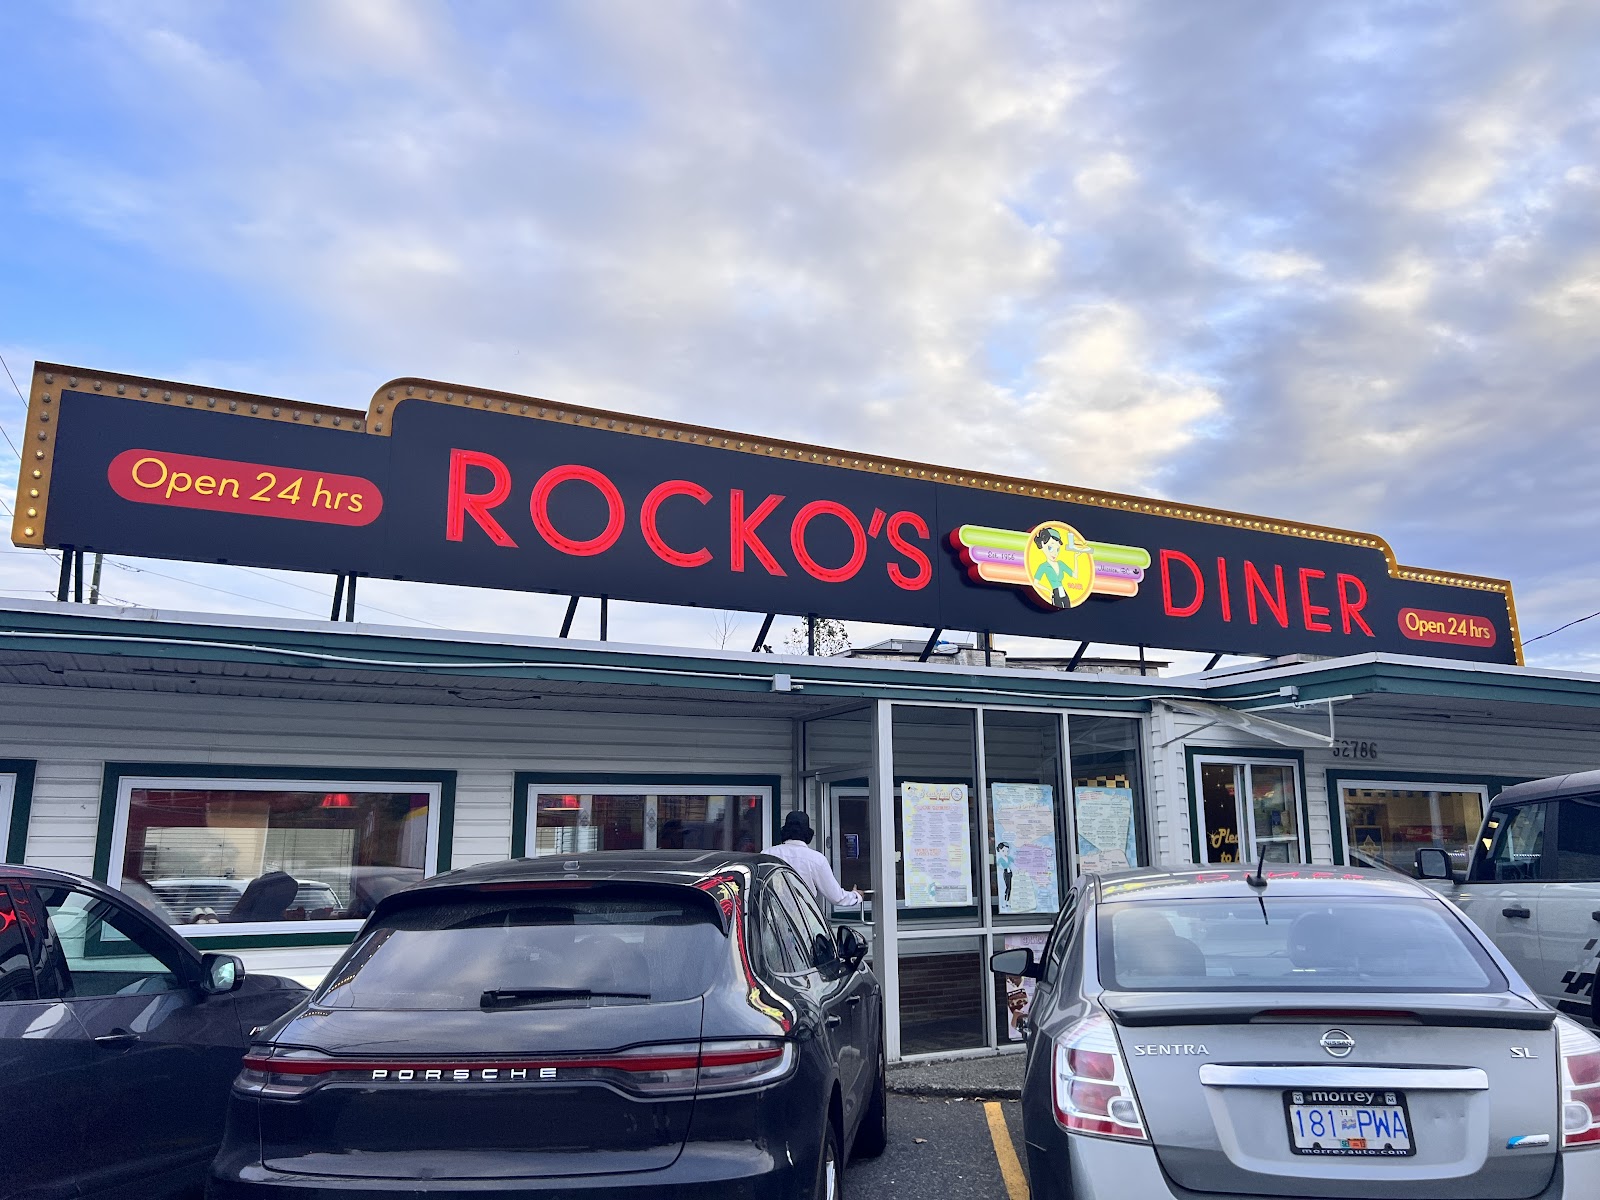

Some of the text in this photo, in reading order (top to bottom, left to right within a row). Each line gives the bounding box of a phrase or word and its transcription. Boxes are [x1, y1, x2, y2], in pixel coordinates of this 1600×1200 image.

[130, 457, 363, 513] Open 24 hrs
[446, 448, 1375, 637] ROCKO'S DINER
[1404, 612, 1491, 639] Open 24 hrs
[1133, 1044, 1210, 1056] SENTRA
[1510, 1047, 1539, 1058] SL
[372, 1067, 557, 1080] PORSCHE
[1312, 1091, 1375, 1104] morrey
[1296, 1109, 1408, 1138] 181 PWA
